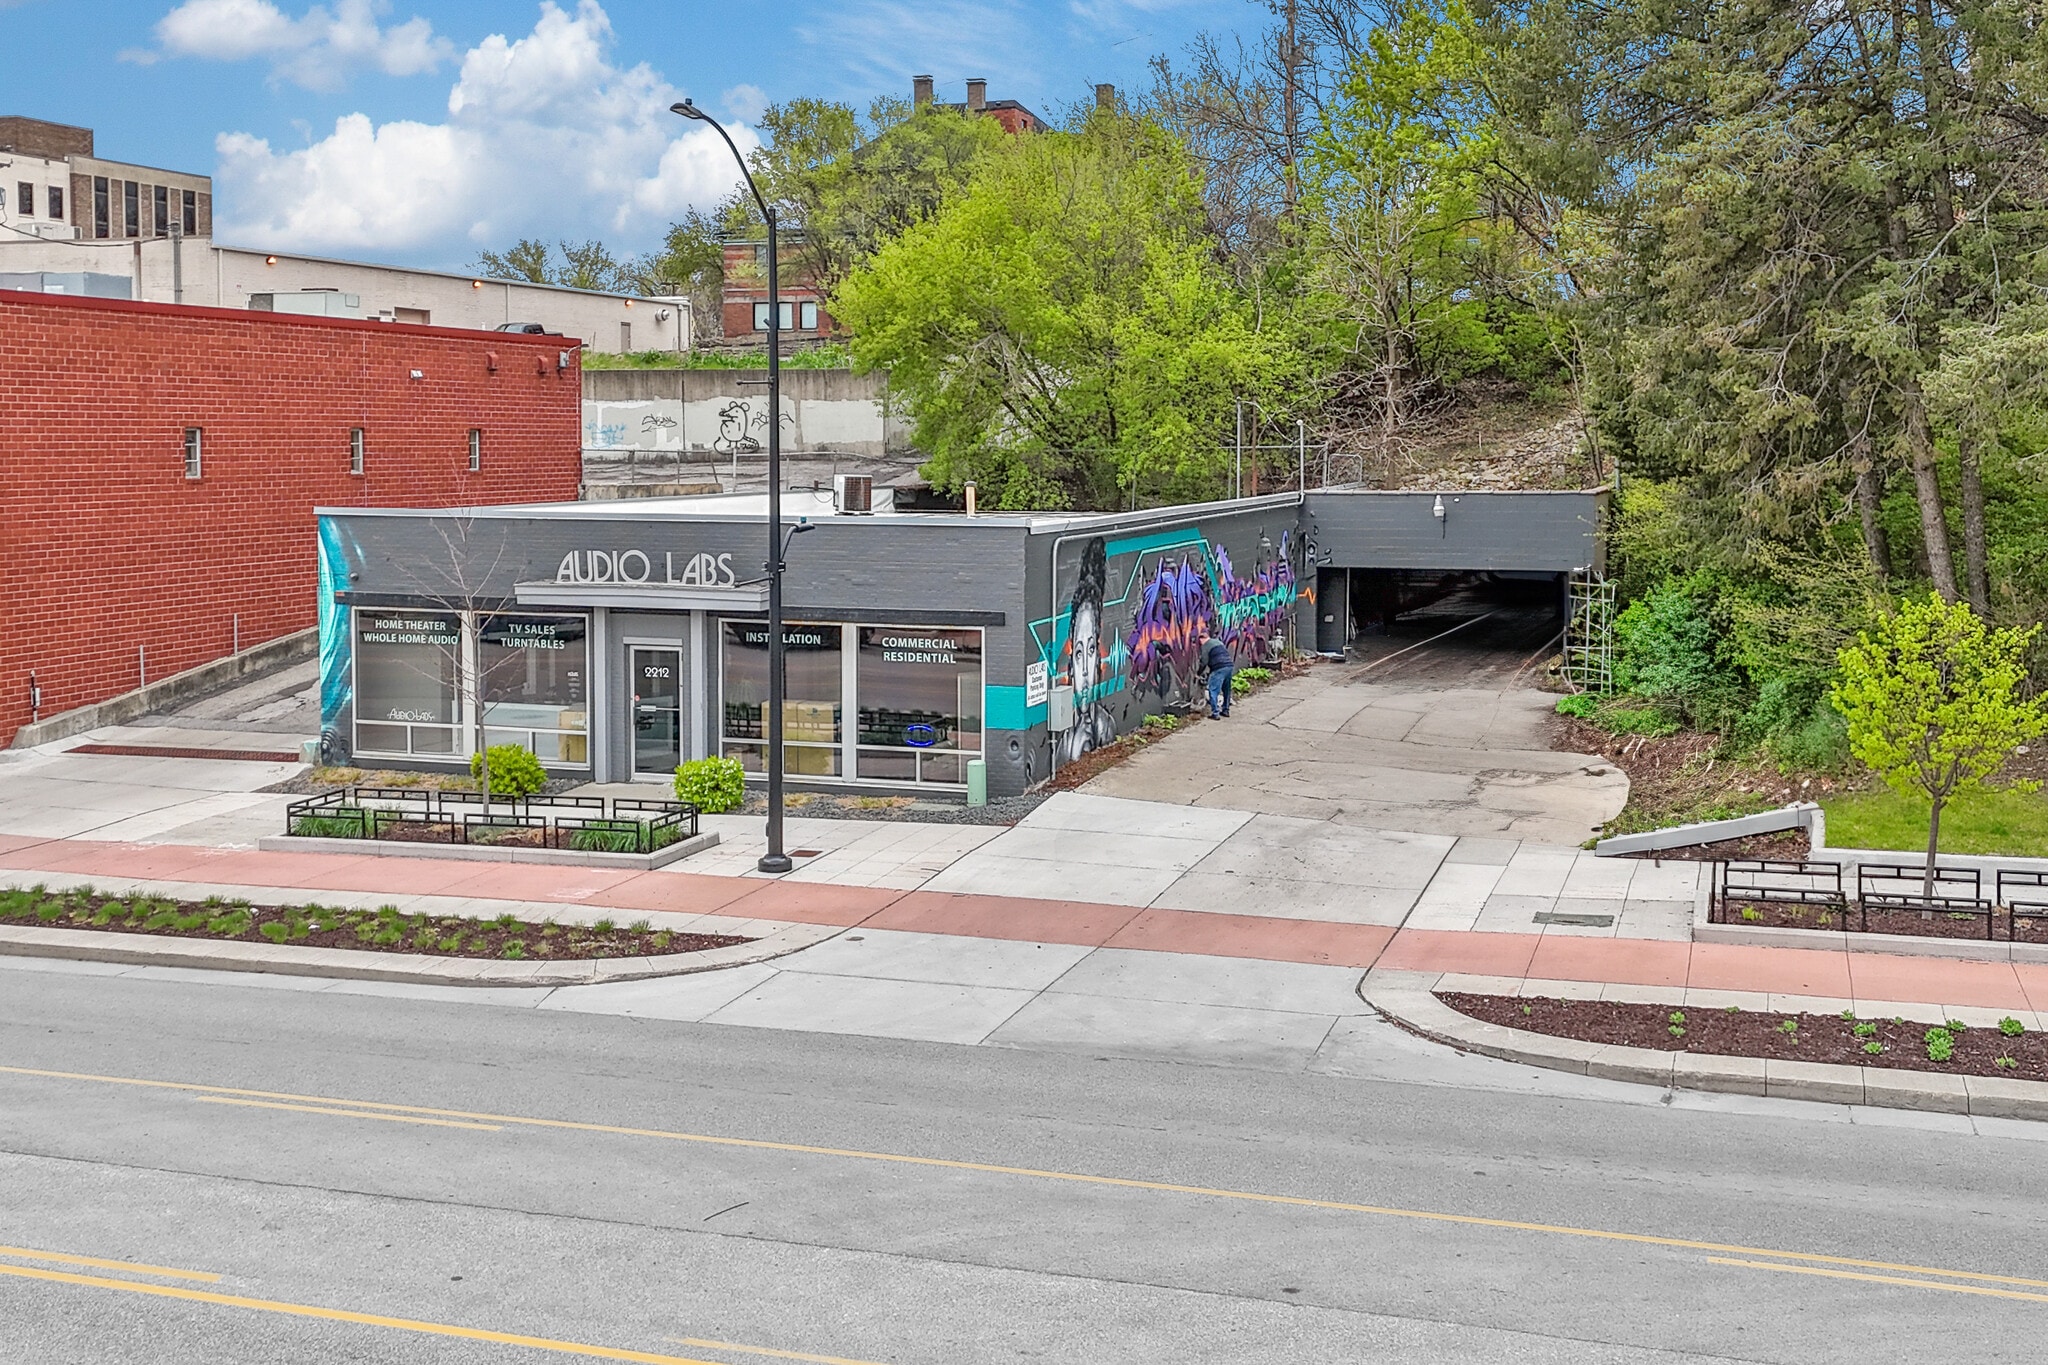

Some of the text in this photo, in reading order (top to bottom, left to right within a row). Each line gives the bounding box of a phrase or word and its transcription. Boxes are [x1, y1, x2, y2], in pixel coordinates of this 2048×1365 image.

[556, 549, 736, 586] AUDIO LABS
[375, 619, 446, 632] HOME THEATER
[508, 623, 556, 636] TV SALES
[363, 632, 459, 646] WHOLE HOME AUDIO
[500, 637, 565, 650] TURNTABLES
[745, 631, 821, 645] INSTLATION
[882, 637, 957, 649] COMMERCIAL
[883, 651, 957, 664] RESIDENTIAL
[644, 666, 670, 678] 2212
